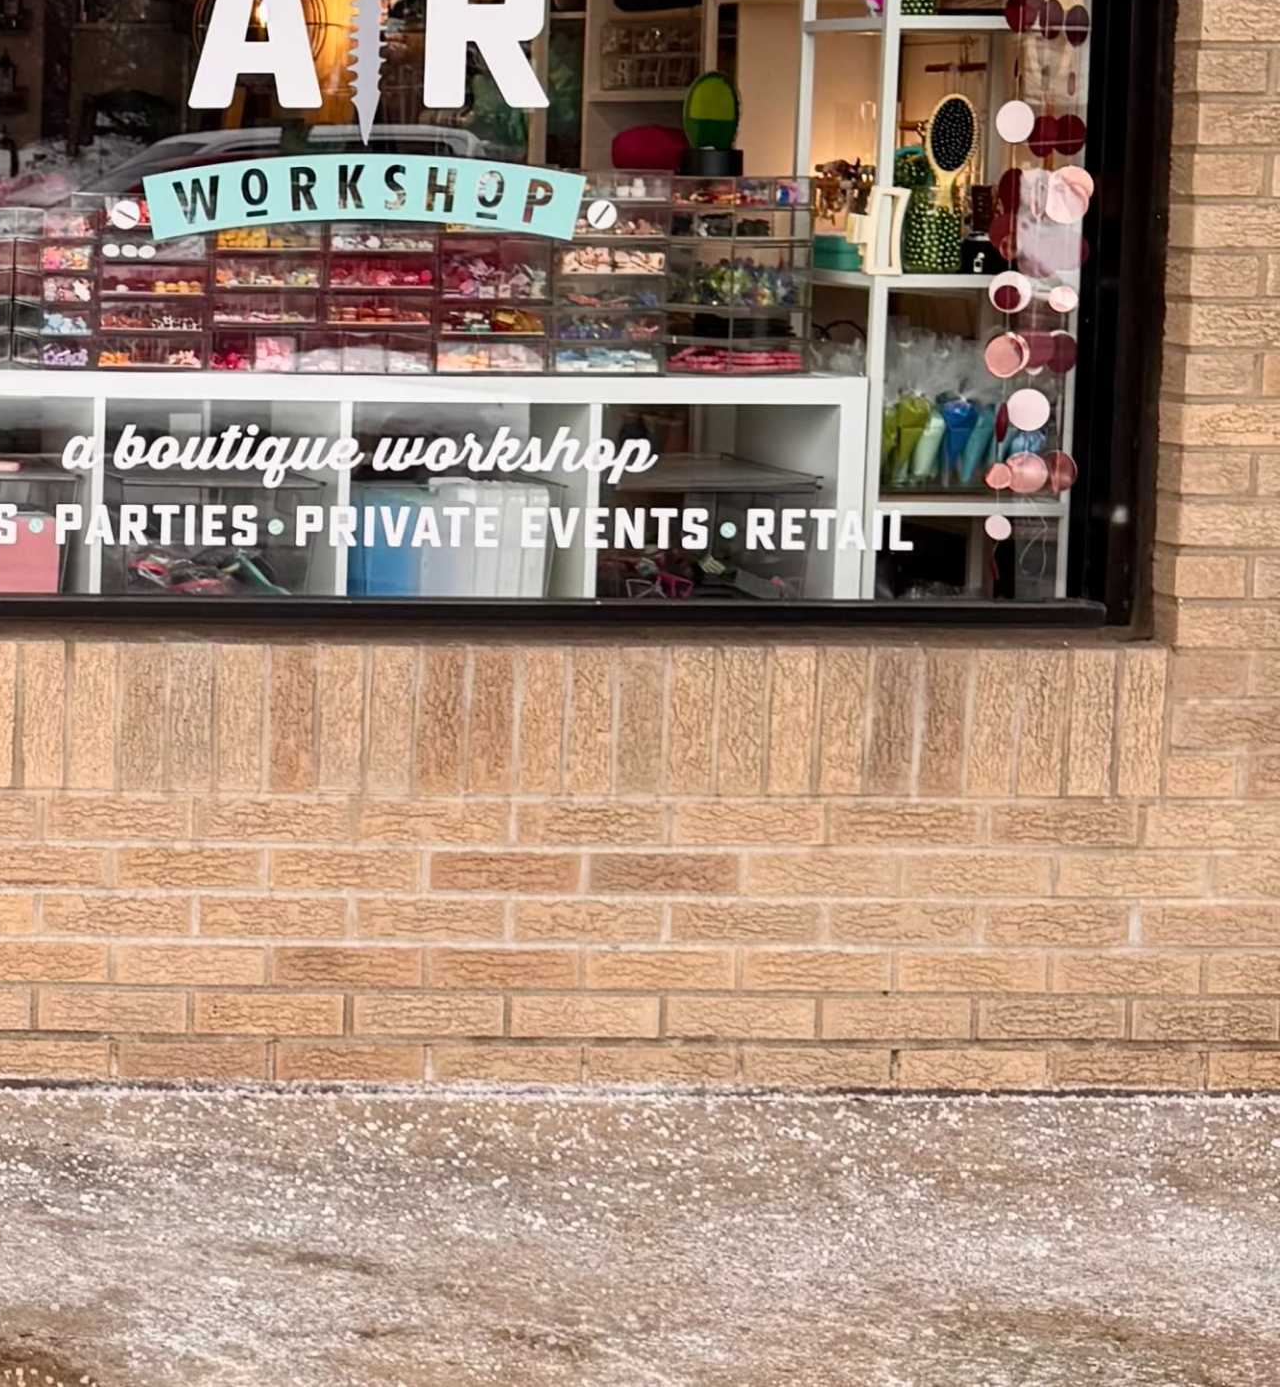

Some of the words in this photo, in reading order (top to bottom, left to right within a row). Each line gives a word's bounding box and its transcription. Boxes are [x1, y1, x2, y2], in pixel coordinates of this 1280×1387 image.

[172, 163, 556, 226] WORKSHOP
[61, 432, 98, 470] a
[113, 424, 365, 489] boutique
[372, 426, 658, 485] workshop
[55, 504, 258, 547] PARTIES
[295, 505, 499, 548] PRIVATE
[521, 506, 709, 550] EVENTS
[746, 508, 914, 552] RETAIL
